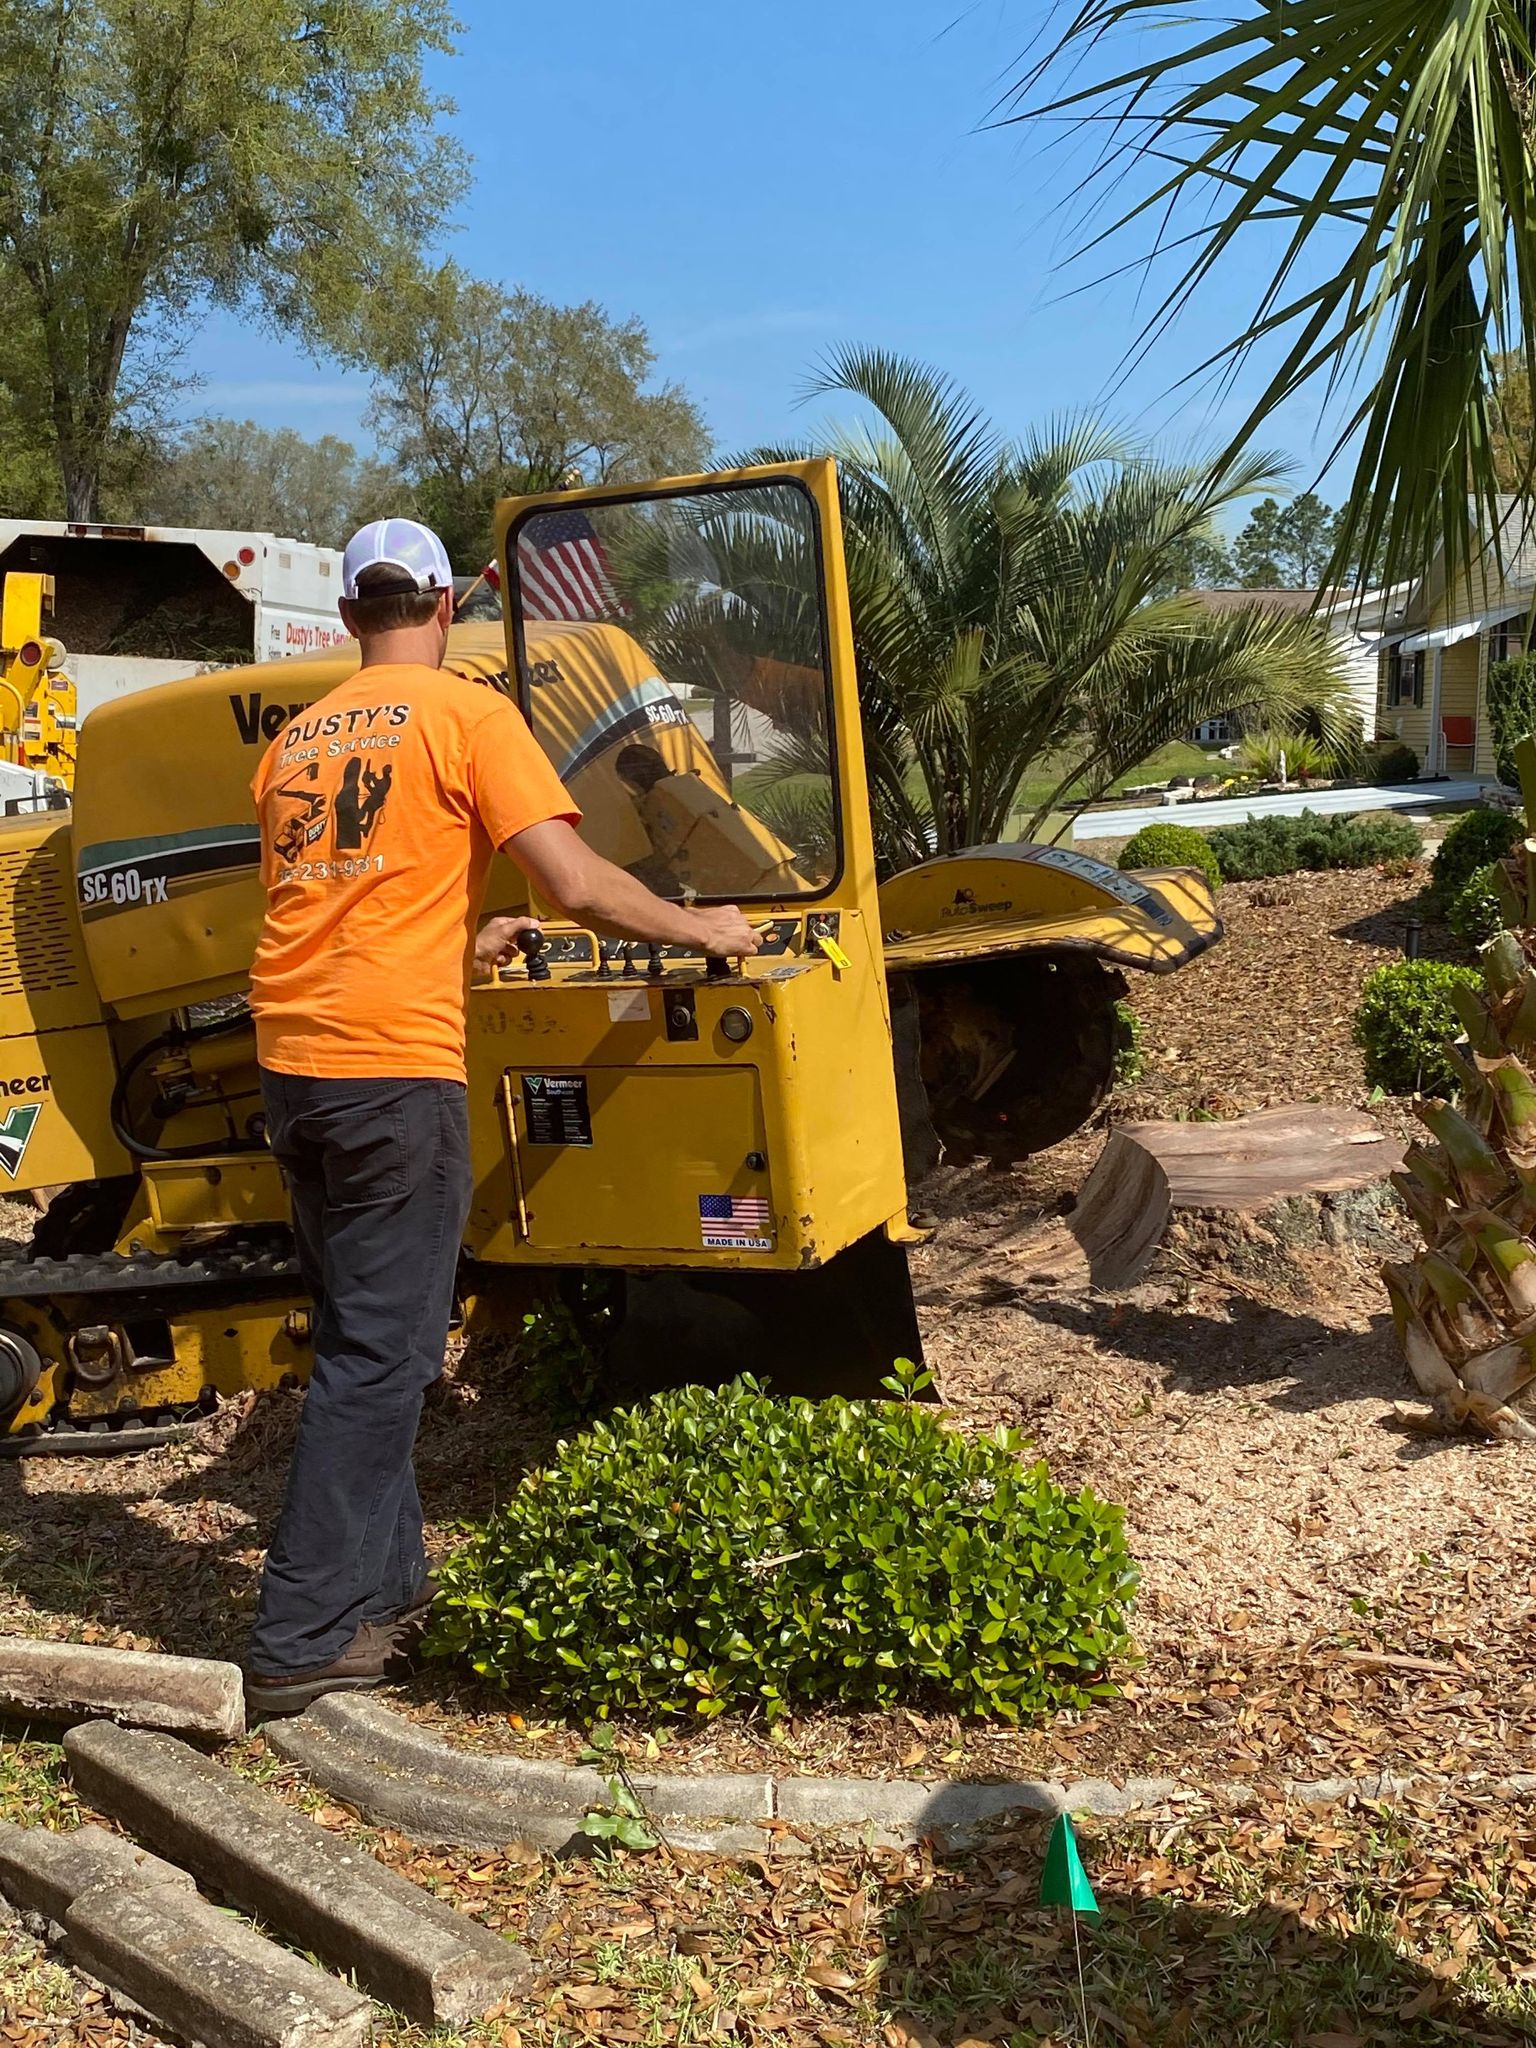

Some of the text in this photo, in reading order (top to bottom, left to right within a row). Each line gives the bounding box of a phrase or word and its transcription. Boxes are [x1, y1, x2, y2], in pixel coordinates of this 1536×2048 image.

[286, 622, 313, 653] Dusty's
[314, 626, 331, 649] Tree
[284, 704, 410, 750] DUSTY'S
[280, 732, 401, 769] Tree Service
[543, 1077, 583, 1089] Vermeer
[707, 1238, 768, 1247] MADE IN USA
